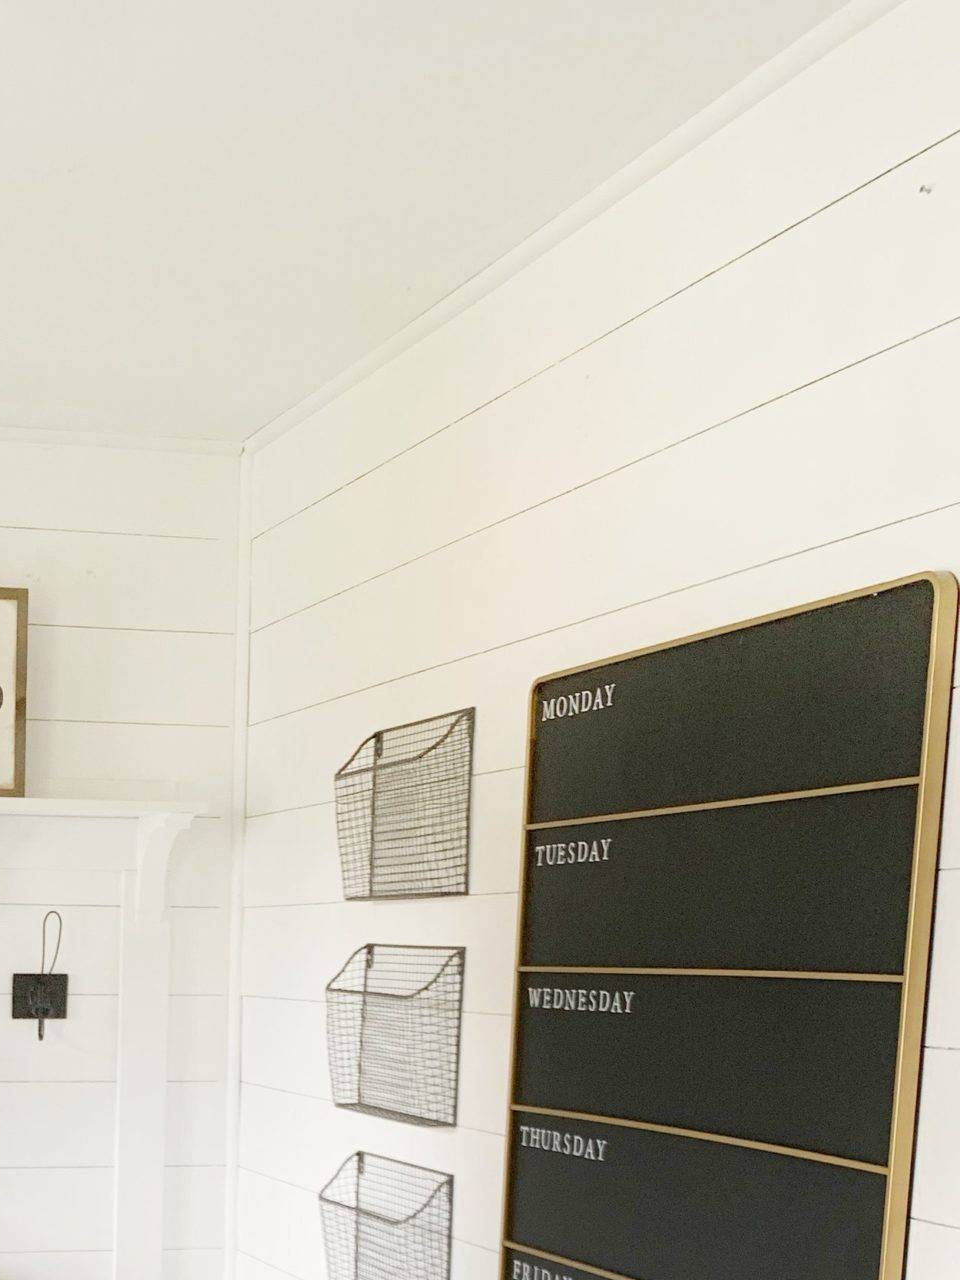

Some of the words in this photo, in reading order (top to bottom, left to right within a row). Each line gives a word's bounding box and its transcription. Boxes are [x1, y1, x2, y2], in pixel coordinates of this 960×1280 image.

[541, 683, 617, 722] MONDAY
[535, 838, 613, 867] TUESDAY
[527, 987, 635, 1014] WEDNESDAY
[519, 1125, 608, 1162] THURSDAY
